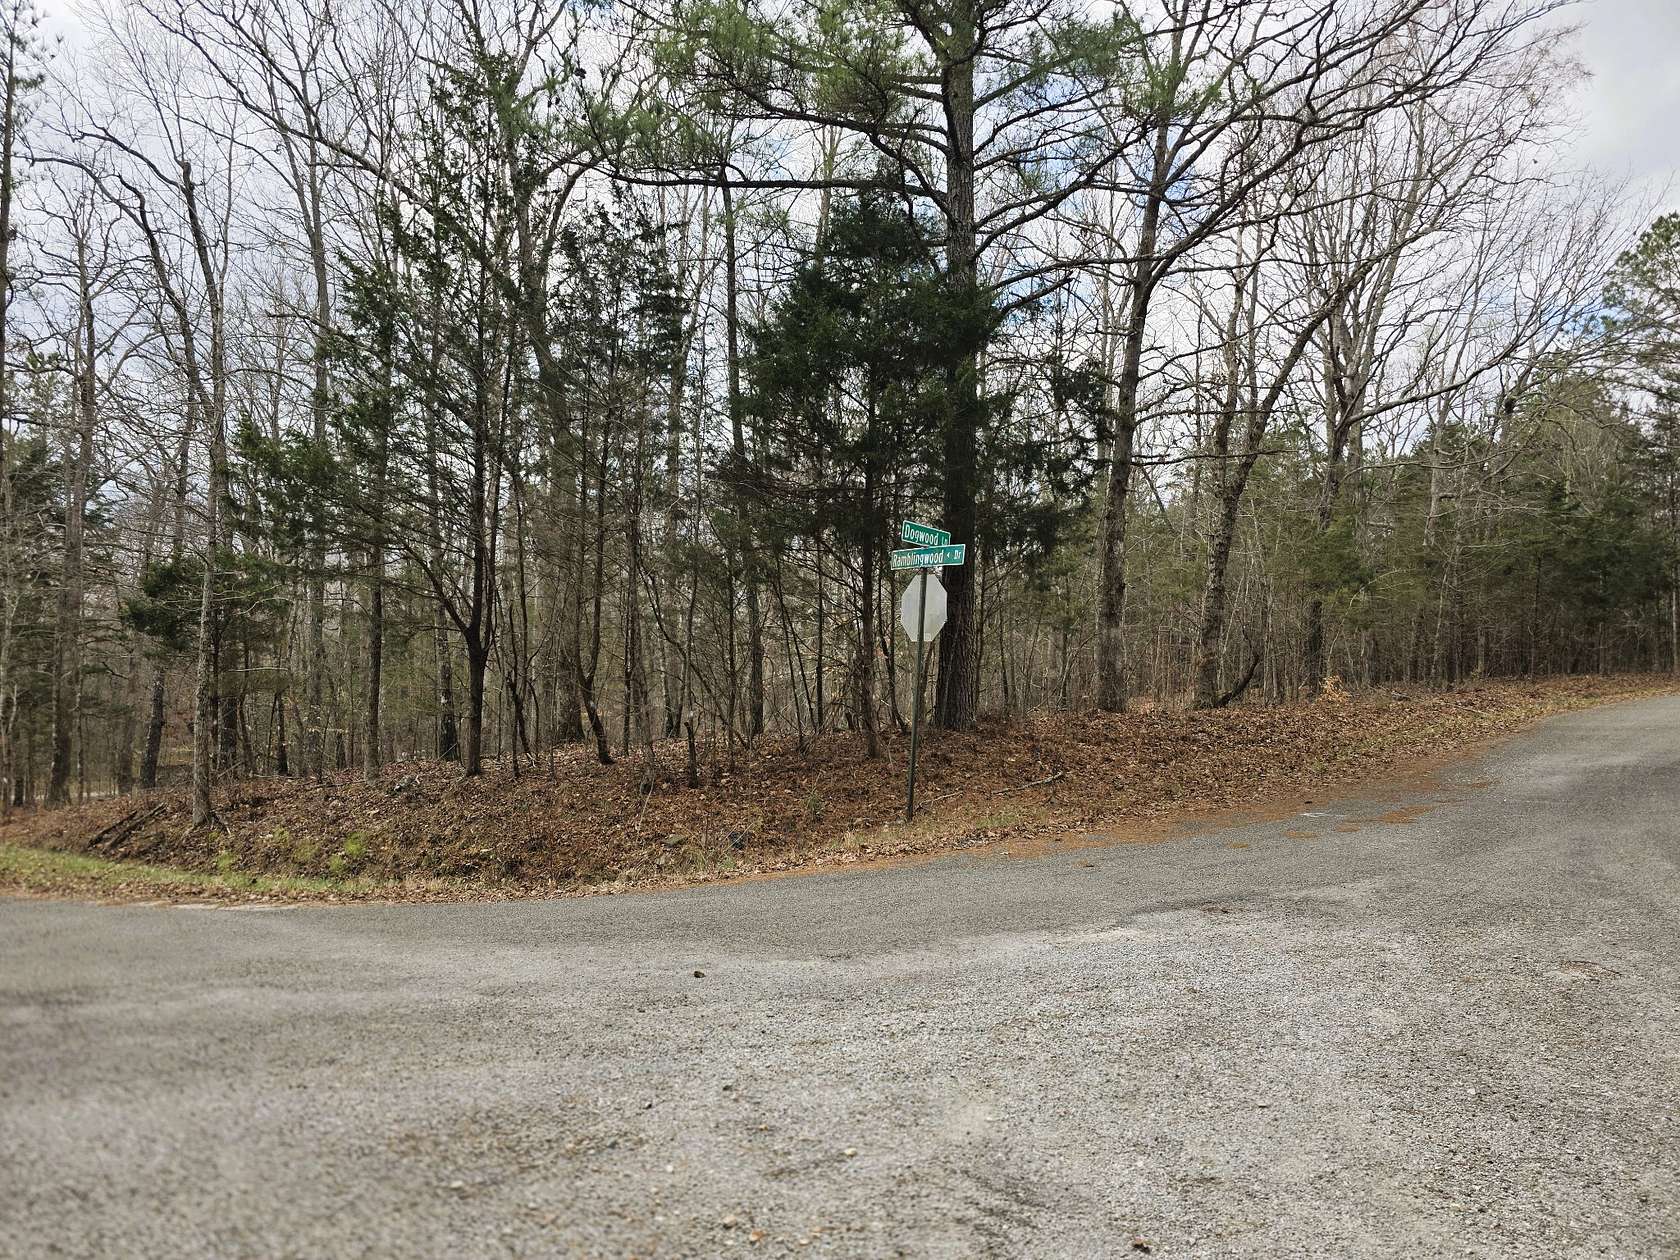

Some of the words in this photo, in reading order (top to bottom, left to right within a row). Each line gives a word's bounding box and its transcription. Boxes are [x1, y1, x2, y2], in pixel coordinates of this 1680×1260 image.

[904, 524, 939, 546] Dogwood
[892, 549, 944, 567] Ramblingwood
[954, 549, 961, 560] Dr
